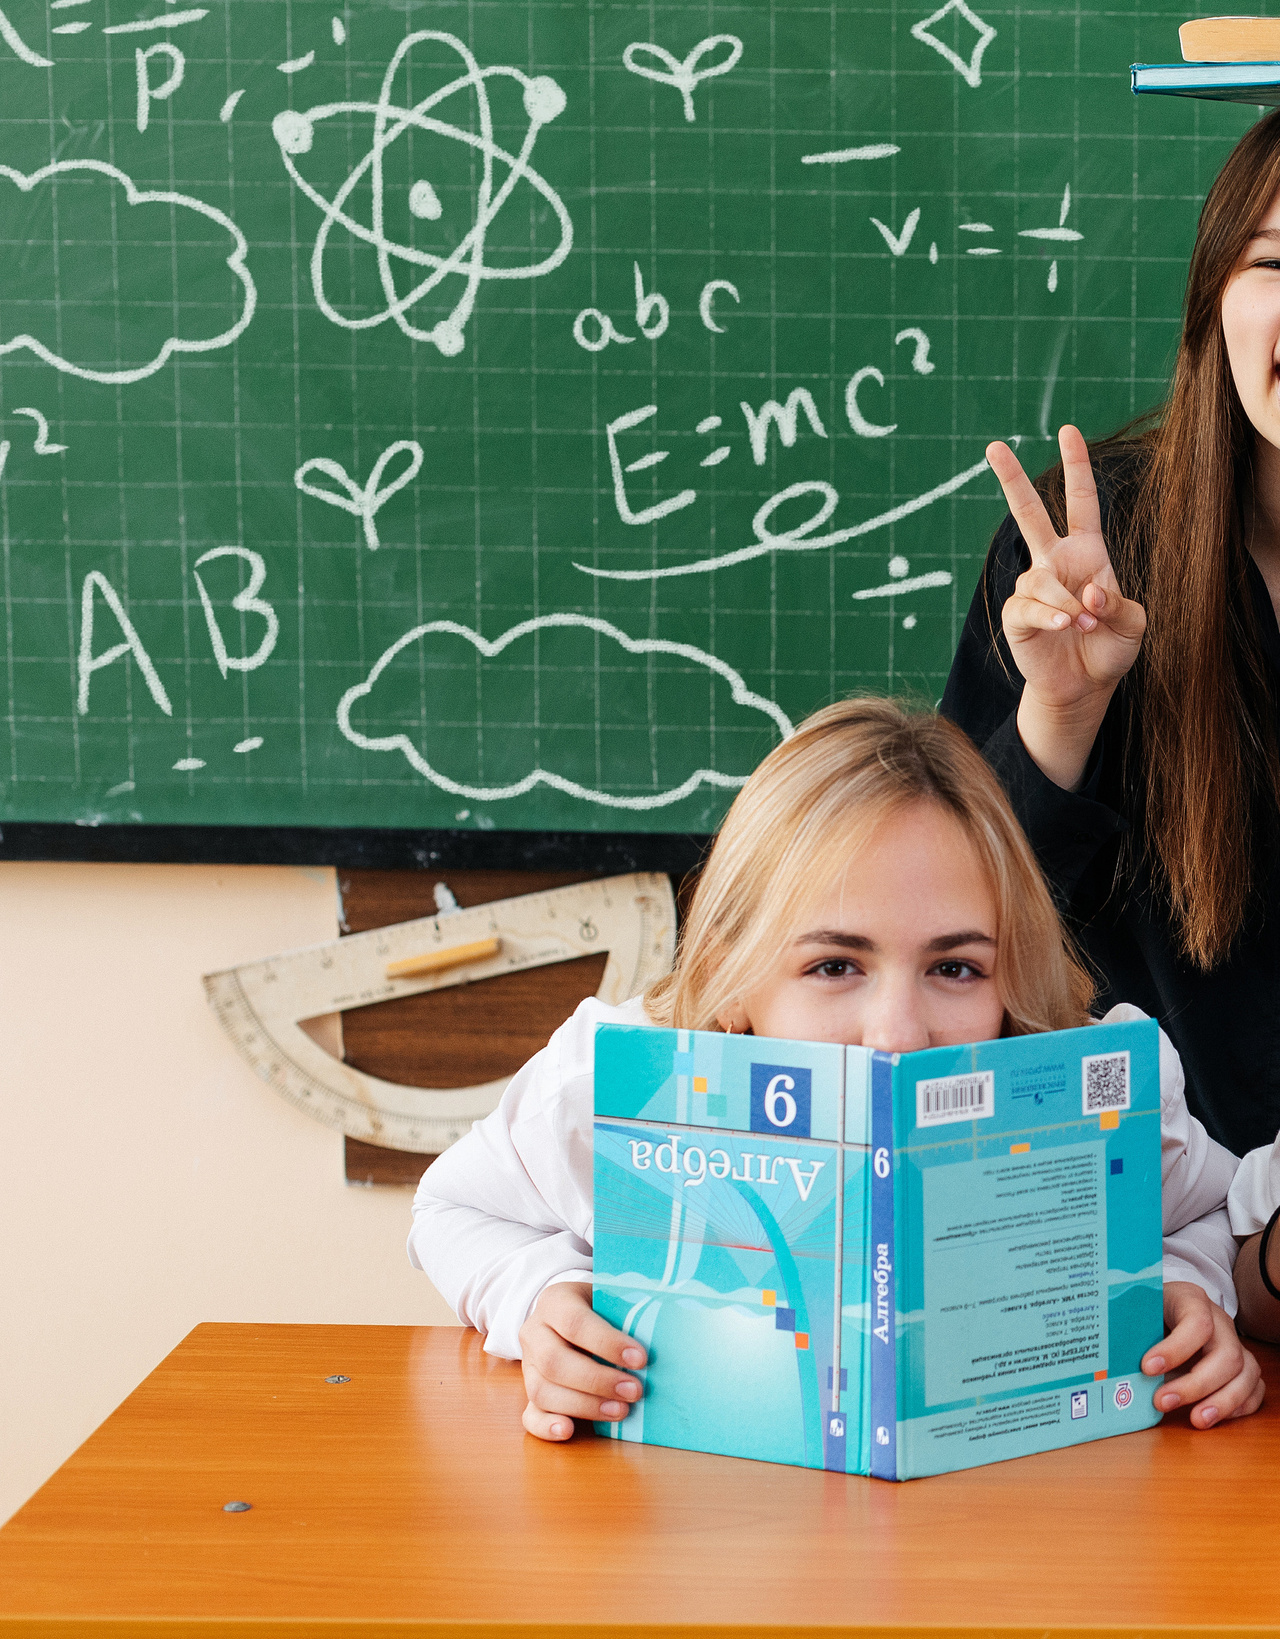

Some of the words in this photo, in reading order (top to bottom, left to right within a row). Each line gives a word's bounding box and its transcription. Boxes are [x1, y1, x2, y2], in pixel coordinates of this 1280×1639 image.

[764, 1073, 797, 1127] 9
[627, 1135, 826, 1202] Алгебра
[872, 1242, 890, 1344] Алгебра
